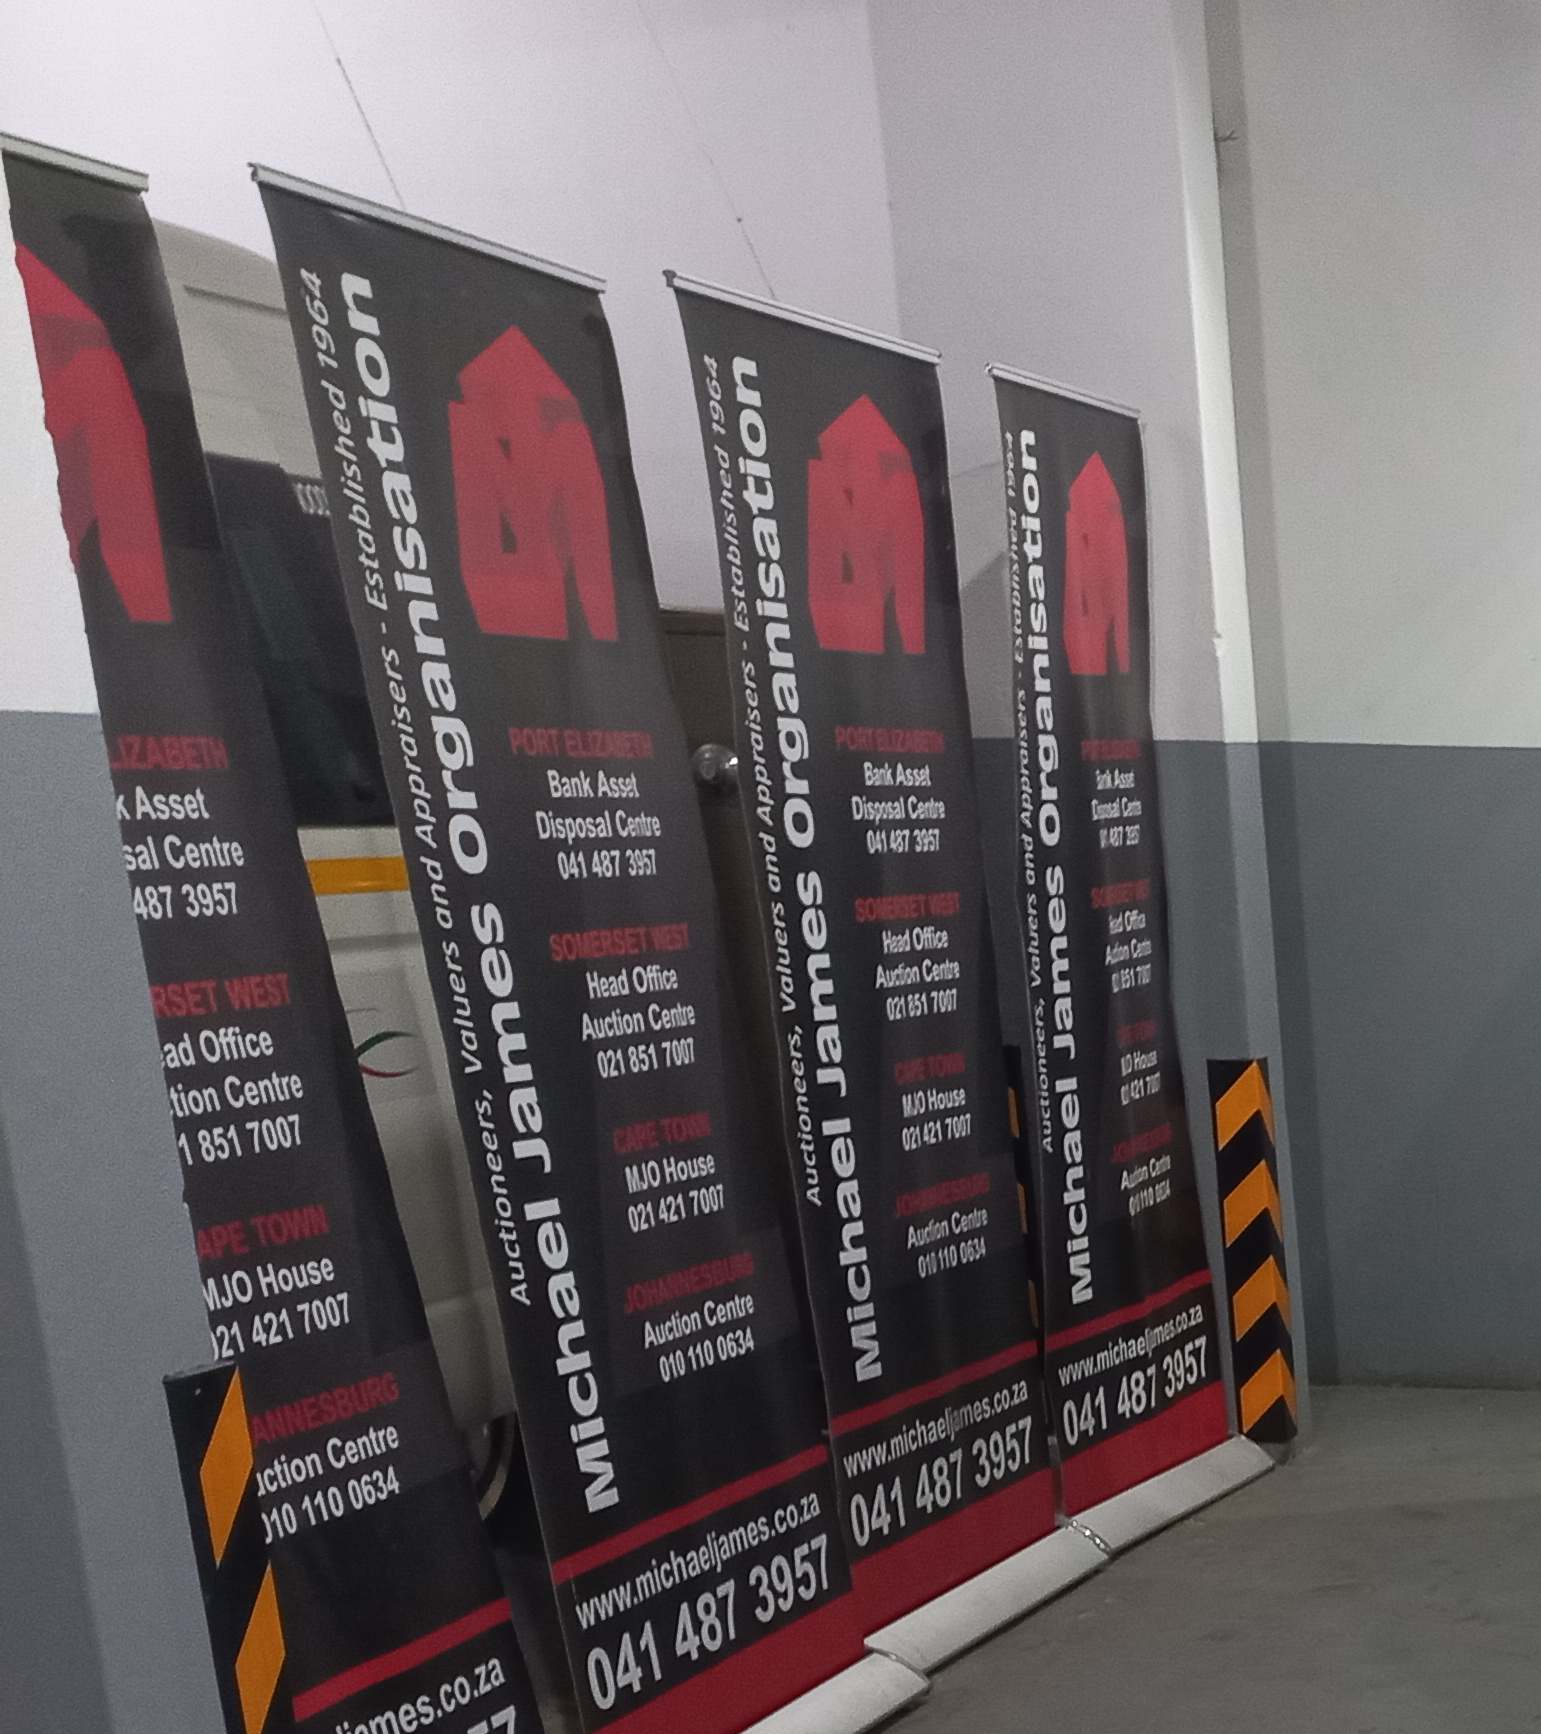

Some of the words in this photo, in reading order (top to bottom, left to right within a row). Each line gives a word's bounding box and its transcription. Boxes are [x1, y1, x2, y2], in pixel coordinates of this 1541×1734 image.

[300, 267, 338, 369] 1964
[703, 353, 727, 436] 1964
[320, 380, 389, 612] Established
[713, 444, 750, 632] Established
[340, 271, 489, 876] Organisation
[732, 355, 815, 849] Organisation
[1020, 429, 1061, 847] Organisation
[381, 646, 438, 851] Appraisers
[509, 727, 560, 757] PORT
[741, 659, 774, 827] Appraisers
[135, 785, 210, 821] Asset
[547, 769, 595, 798] Bank
[597, 769, 640, 798] Asset
[163, 834, 245, 869] Centre
[535, 809, 613, 845] Disposal
[615, 808, 662, 837] Centre
[419, 854, 454, 930] and
[557, 850, 588, 880] 041
[591, 849, 621, 878] 487
[625, 848, 657, 876] 3957
[758, 831, 782, 893] and
[133, 884, 173, 920] 487
[181, 881, 239, 918] 3957
[224, 973, 291, 1011] WEST
[586, 968, 630, 1000] Head
[632, 963, 679, 994] Office
[796, 870, 847, 1098] James
[1045, 865, 1076, 1060] James
[199, 1026, 275, 1064] Office
[470, 901, 552, 1175] James
[581, 1008, 645, 1042] Auction
[647, 1002, 696, 1031] Centre
[597, 1048, 626, 1079] 021
[628, 1043, 659, 1073] 851
[661, 1037, 695, 1068] 7007
[224, 1072, 304, 1109] Centre
[787, 1024, 822, 1207] Auctioneers,
[927, 1087, 966, 1113] House
[197, 1124, 243, 1163] 851
[245, 1114, 302, 1154] 7007
[474, 1088, 531, 1307] Auctioneers,
[625, 1159, 661, 1194] MJO
[662, 1153, 716, 1185] House
[1055, 1076, 1093, 1305] Michael
[198, 1220, 249, 1260] APE
[251, 1205, 330, 1247] TOWN
[628, 1202, 655, 1233] 021
[658, 1193, 687, 1224] 421
[688, 1184, 725, 1217] 7007
[951, 1207, 988, 1235] Centre
[257, 1257, 335, 1298] House
[821, 1117, 883, 1383] Michael
[252, 1308, 295, 1348] 421
[296, 1292, 351, 1335] 7007
[644, 1309, 702, 1350] Auction
[703, 1293, 755, 1328] Centre
[523, 1197, 621, 1514] Michael
[659, 1349, 686, 1383] 010
[687, 1339, 715, 1372] 110
[716, 1325, 755, 1362] 0634
[1063, 1385, 1108, 1446] 041
[1117, 1363, 1157, 1419] 487
[1162, 1335, 1207, 1398] 3957
[326, 1425, 400, 1470] Centre
[301, 1486, 345, 1526] 110
[348, 1464, 401, 1511] 0634
[850, 1476, 907, 1547] 041
[916, 1448, 963, 1514] 487
[972, 1415, 1032, 1488] 3957
[575, 1492, 822, 1630] www.michaeljames.co.za
[587, 1619, 662, 1710] 041
[674, 1578, 736, 1662] 487
[749, 1533, 829, 1624] 3957
